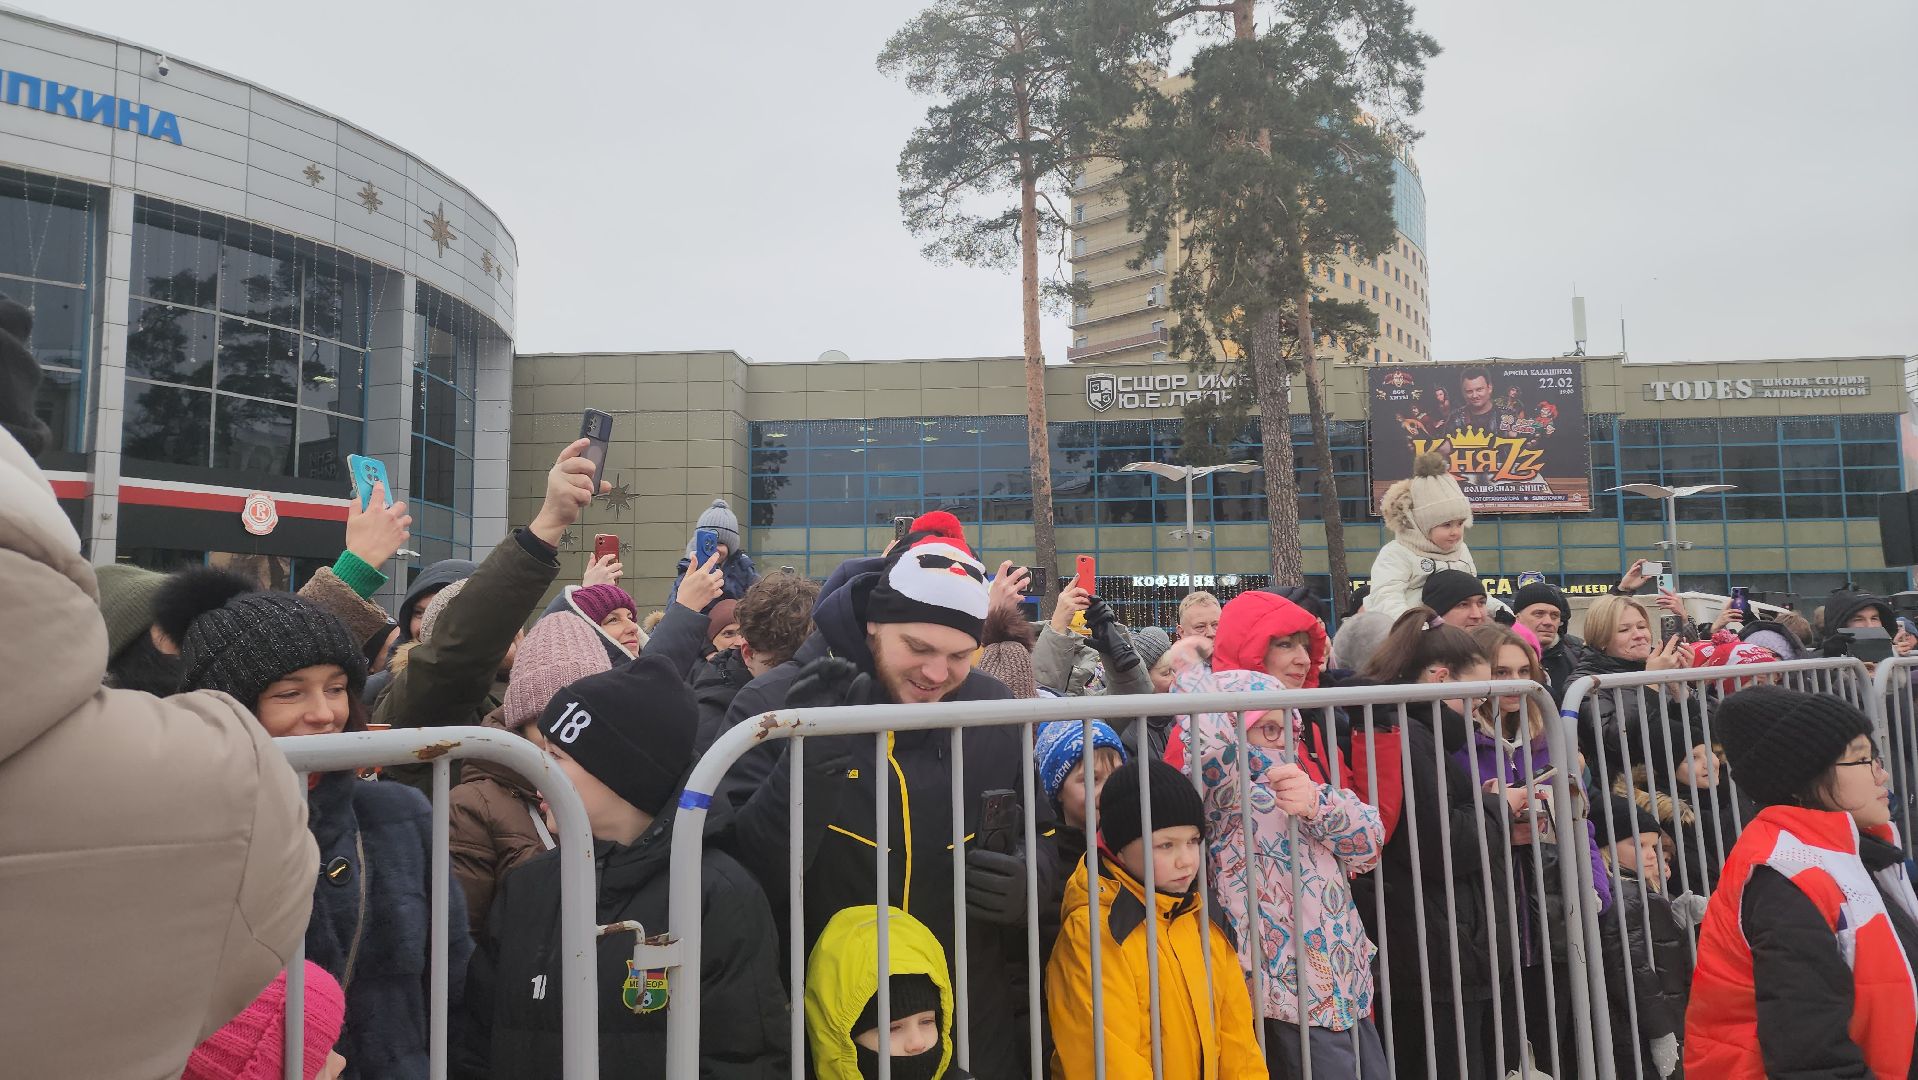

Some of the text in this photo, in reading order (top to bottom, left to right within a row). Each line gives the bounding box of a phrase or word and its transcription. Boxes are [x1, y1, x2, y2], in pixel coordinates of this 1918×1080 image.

[0, 68, 183, 146] ПКИНА
[1117, 374, 1188, 392] СШОР
[1539, 377, 1574, 389] 22.02
[1650, 379, 1753, 401] TODES
[1762, 375, 1866, 387] ШКОЛА СТУДИЯ
[1763, 386, 1867, 398] АЛЛЫ ДУХОВОЙ
[549, 701, 592, 744] 18
[1051, 760, 1072, 789] SOCHI
[629, 980, 664, 988] МЕЕОР
